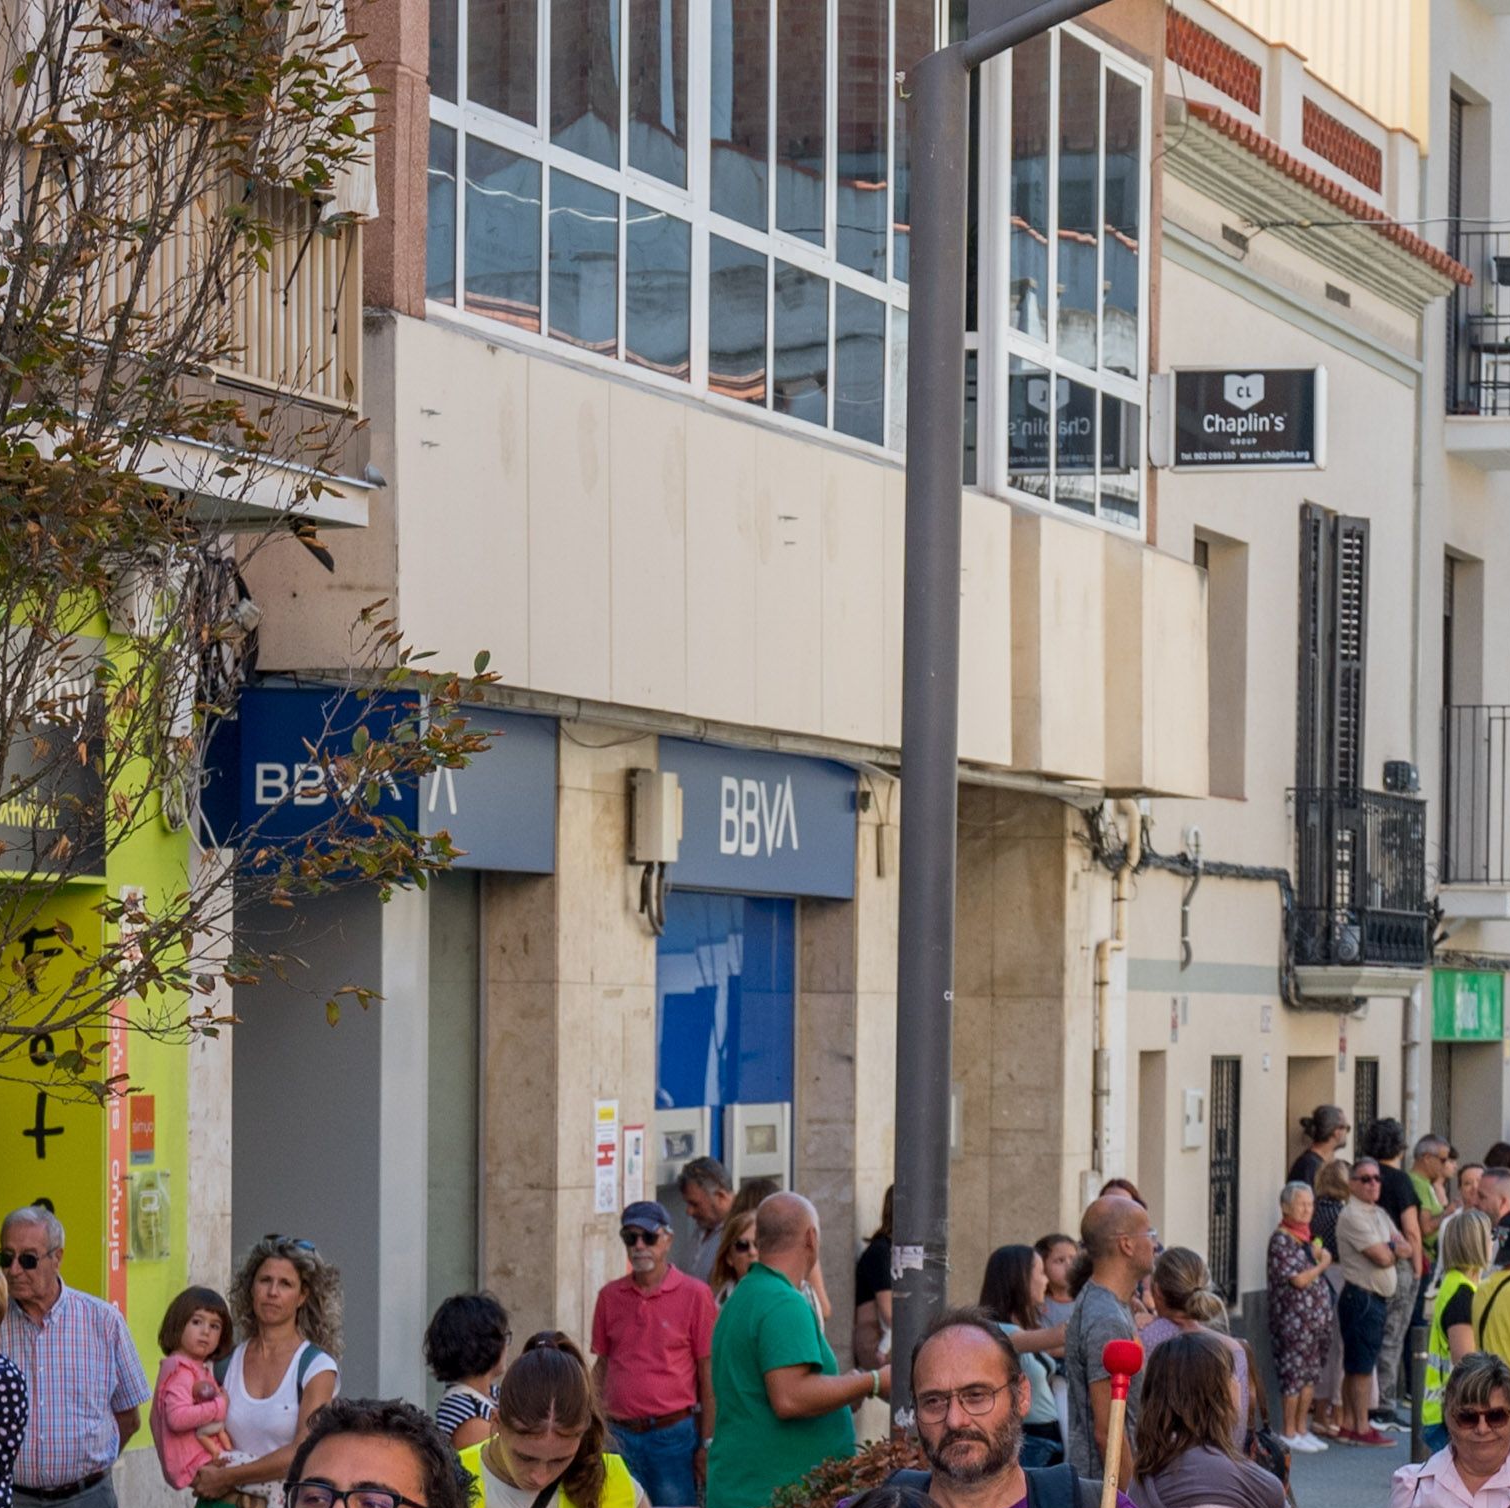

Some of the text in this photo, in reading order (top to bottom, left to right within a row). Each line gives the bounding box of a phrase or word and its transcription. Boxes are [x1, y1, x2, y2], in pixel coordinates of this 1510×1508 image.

[1236, 386, 1252, 398] CL
[1203, 412, 1285, 437] Chaplin's
[720, 774, 799, 858] BBVA
